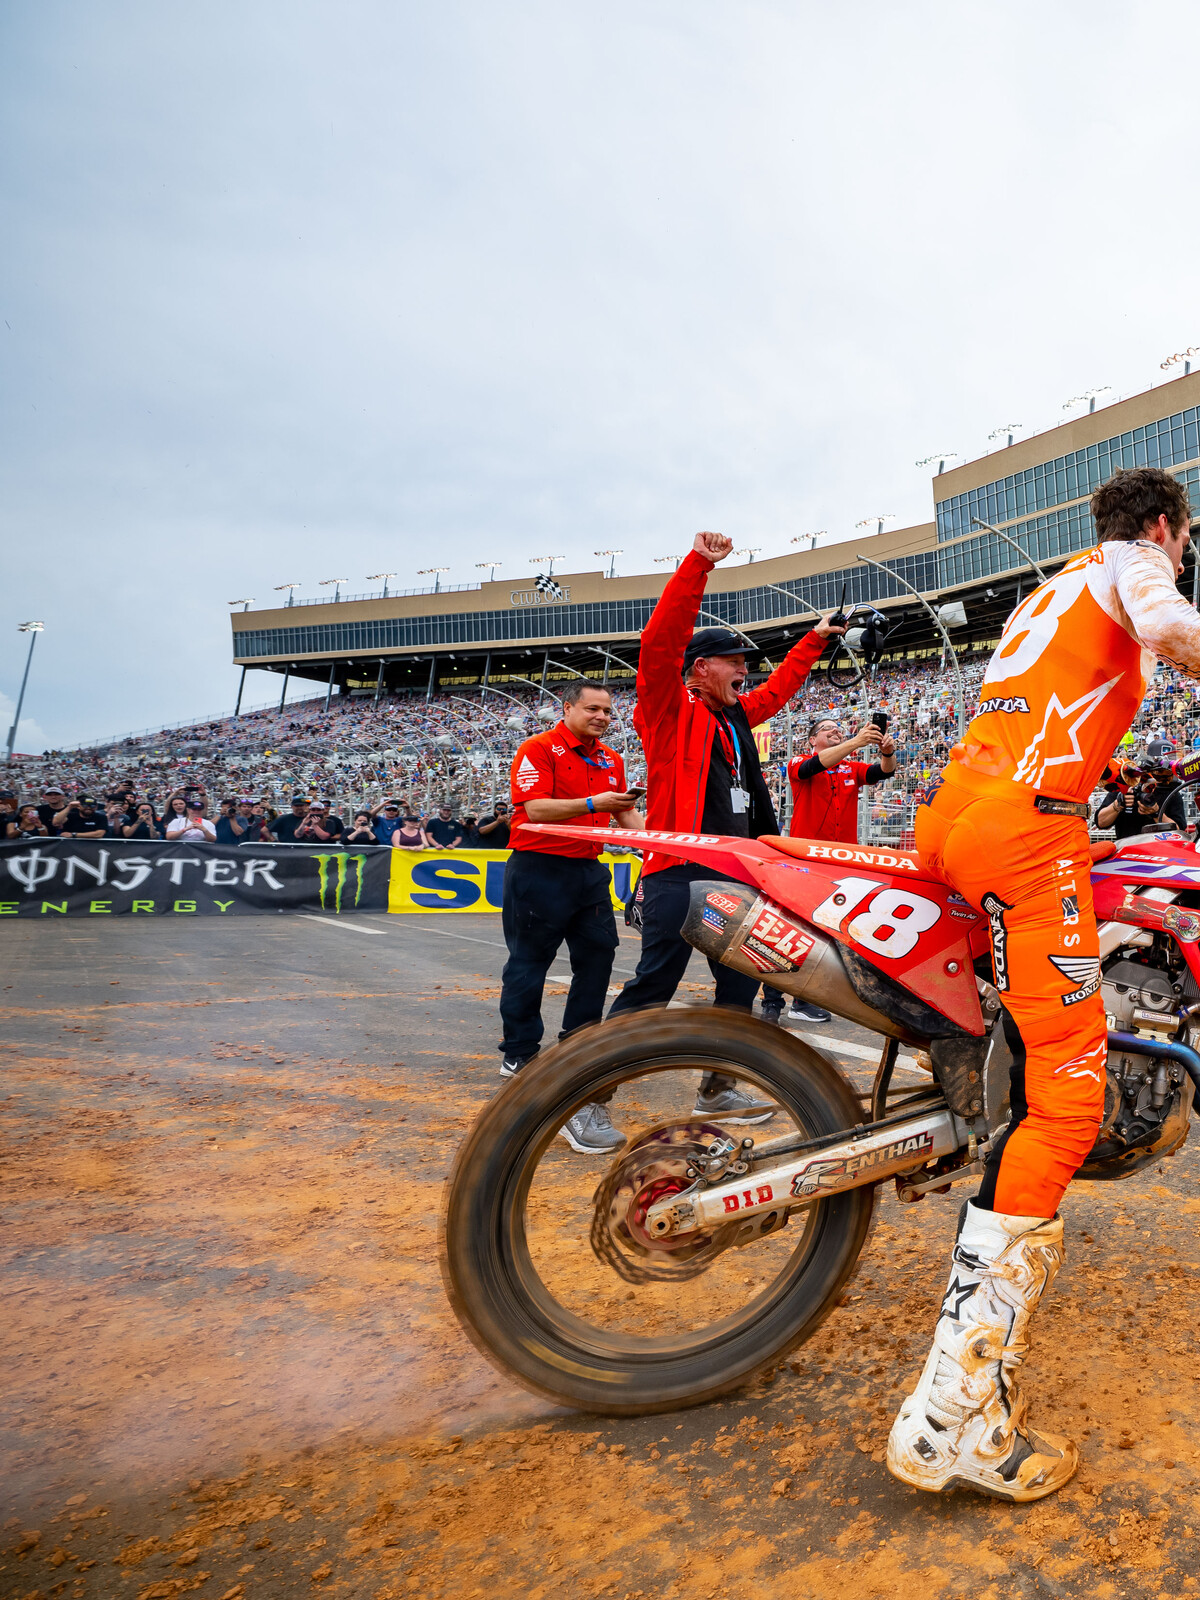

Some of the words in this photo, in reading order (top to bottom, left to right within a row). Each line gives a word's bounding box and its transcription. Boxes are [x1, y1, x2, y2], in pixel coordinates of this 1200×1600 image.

[510, 592, 541, 606] CLUB
[544, 589, 571, 603] ONE
[984, 562, 1089, 684] 8
[592, 829, 719, 845] DUNLOP
[4, 849, 285, 893] ONSTER
[807, 845, 918, 871] HONDA
[0, 900, 235, 914] ENERGY
[811, 876, 942, 959] 18
[950, 909, 967, 919] Twin
[752, 912, 813, 960] ヨシムラ
[1063, 980, 1100, 1006] HOND
